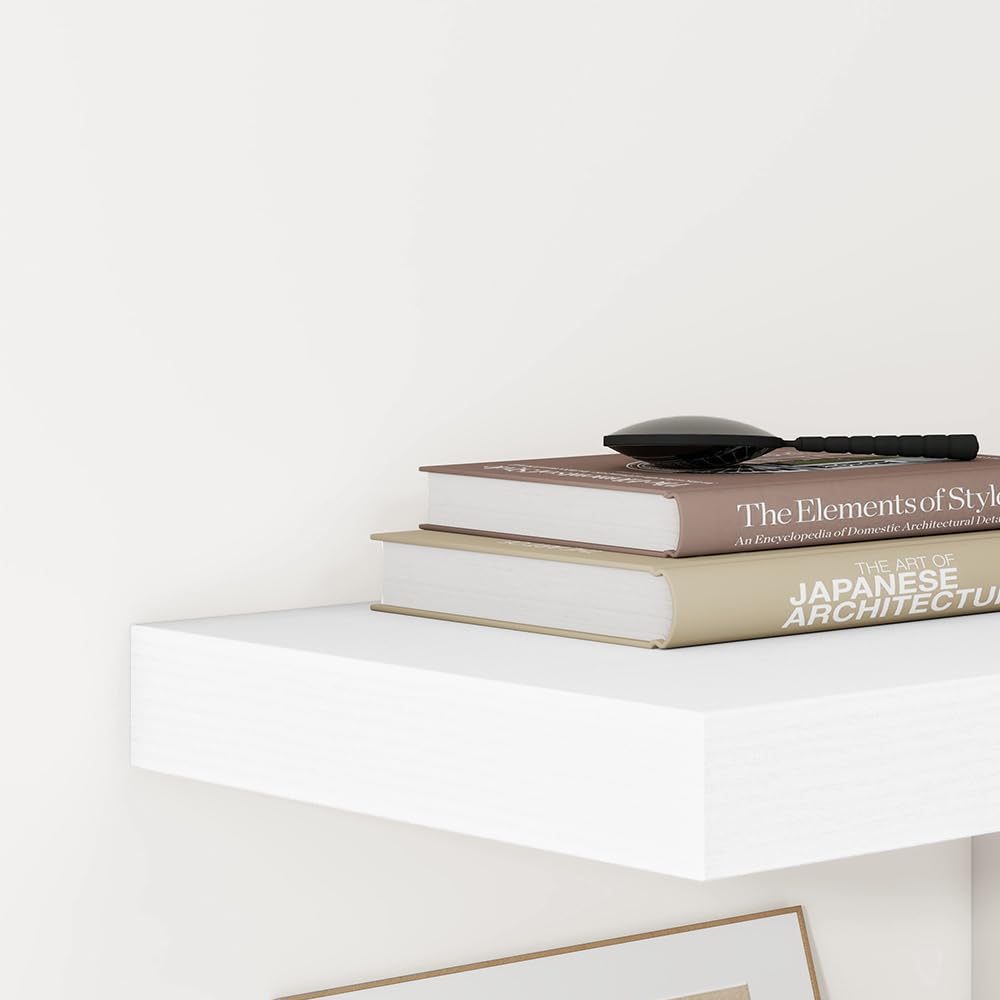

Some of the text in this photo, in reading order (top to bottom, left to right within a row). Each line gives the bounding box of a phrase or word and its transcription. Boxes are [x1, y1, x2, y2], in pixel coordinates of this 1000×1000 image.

[737, 501, 792, 528] The
[796, 494, 916, 523] Elements
[920, 488, 944, 513] of
[735, 536, 752, 546] An
[755, 529, 832, 545] Encyclopedia
[833, 527, 849, 539] of
[848, 523, 900, 537] Domestic
[901, 516, 974, 532] Architectural
[854, 553, 955, 576] THE ART OF
[789, 567, 958, 606] JAPANESE
